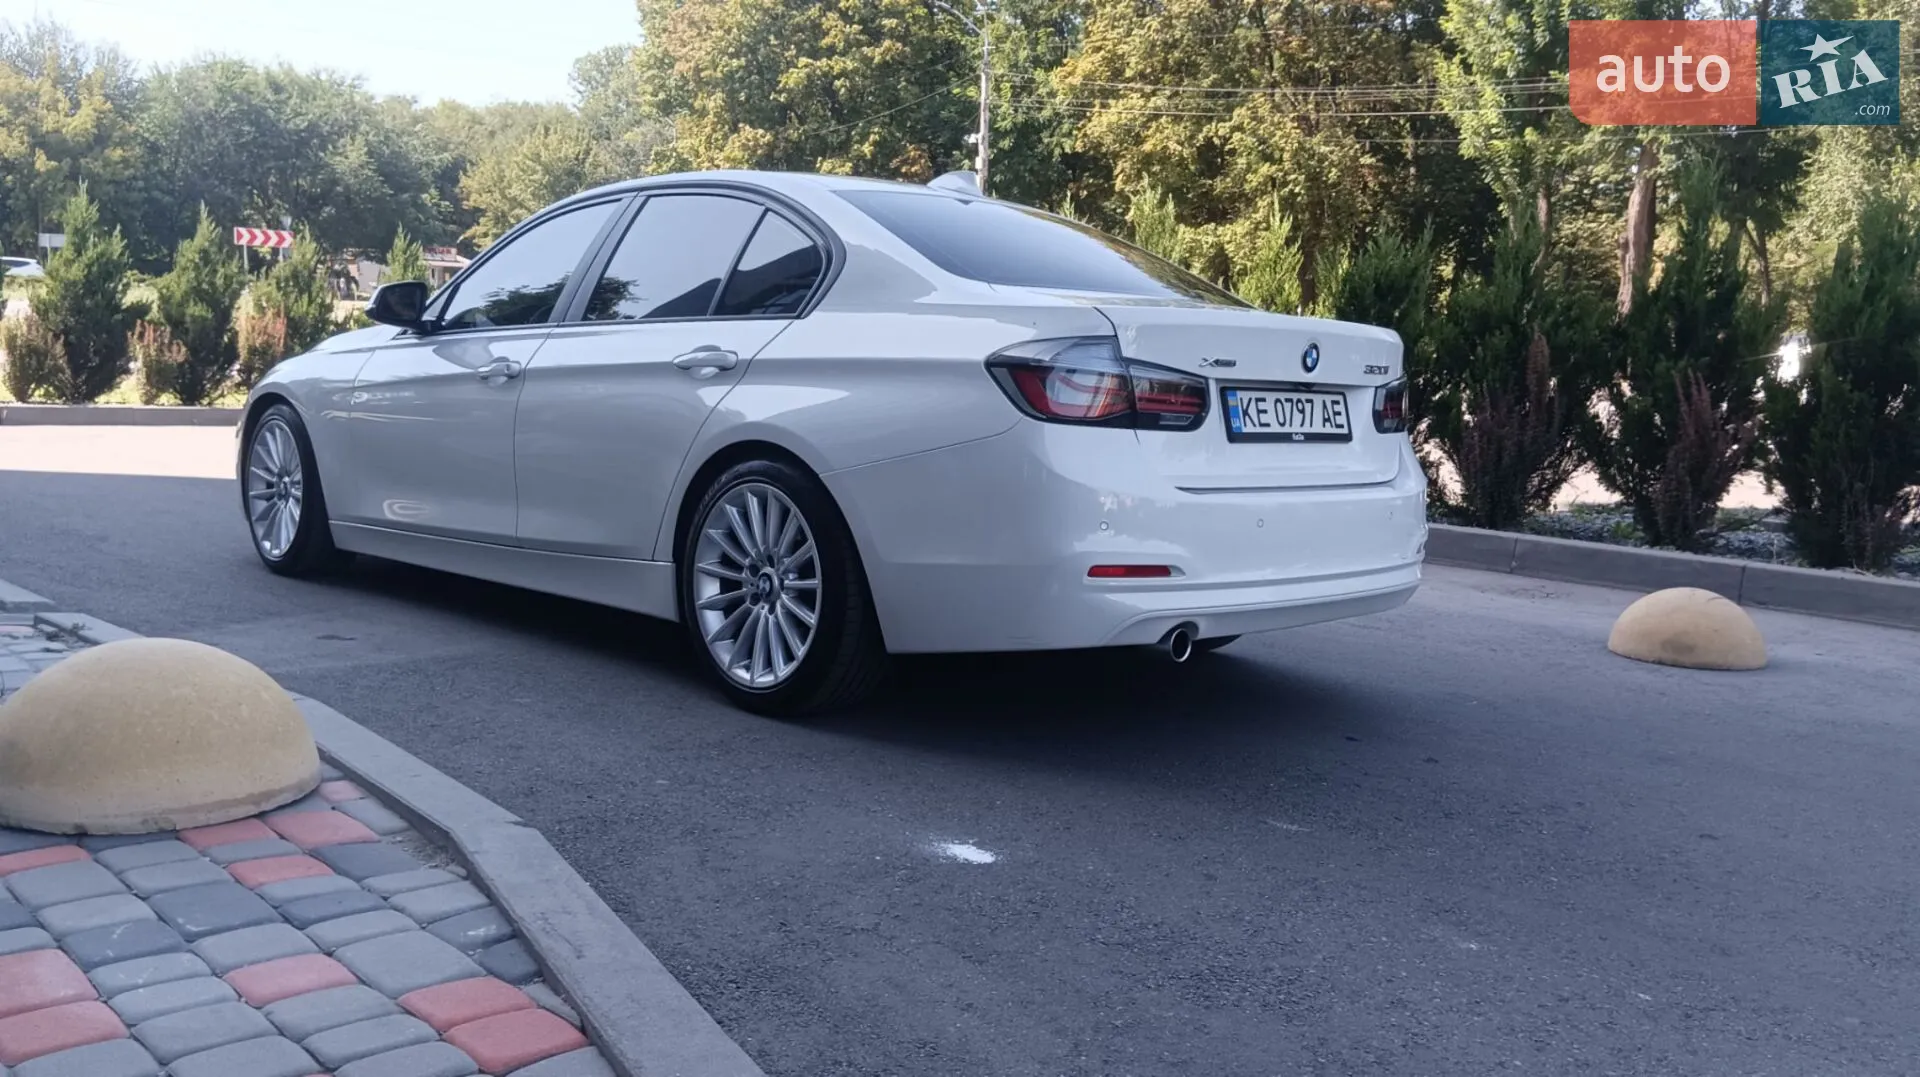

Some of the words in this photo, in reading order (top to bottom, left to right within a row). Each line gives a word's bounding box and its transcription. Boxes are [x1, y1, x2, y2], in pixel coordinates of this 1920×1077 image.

[1240, 397, 1271, 428] KE
[1274, 397, 1314, 428] 0797
[1322, 399, 1345, 428] AE
